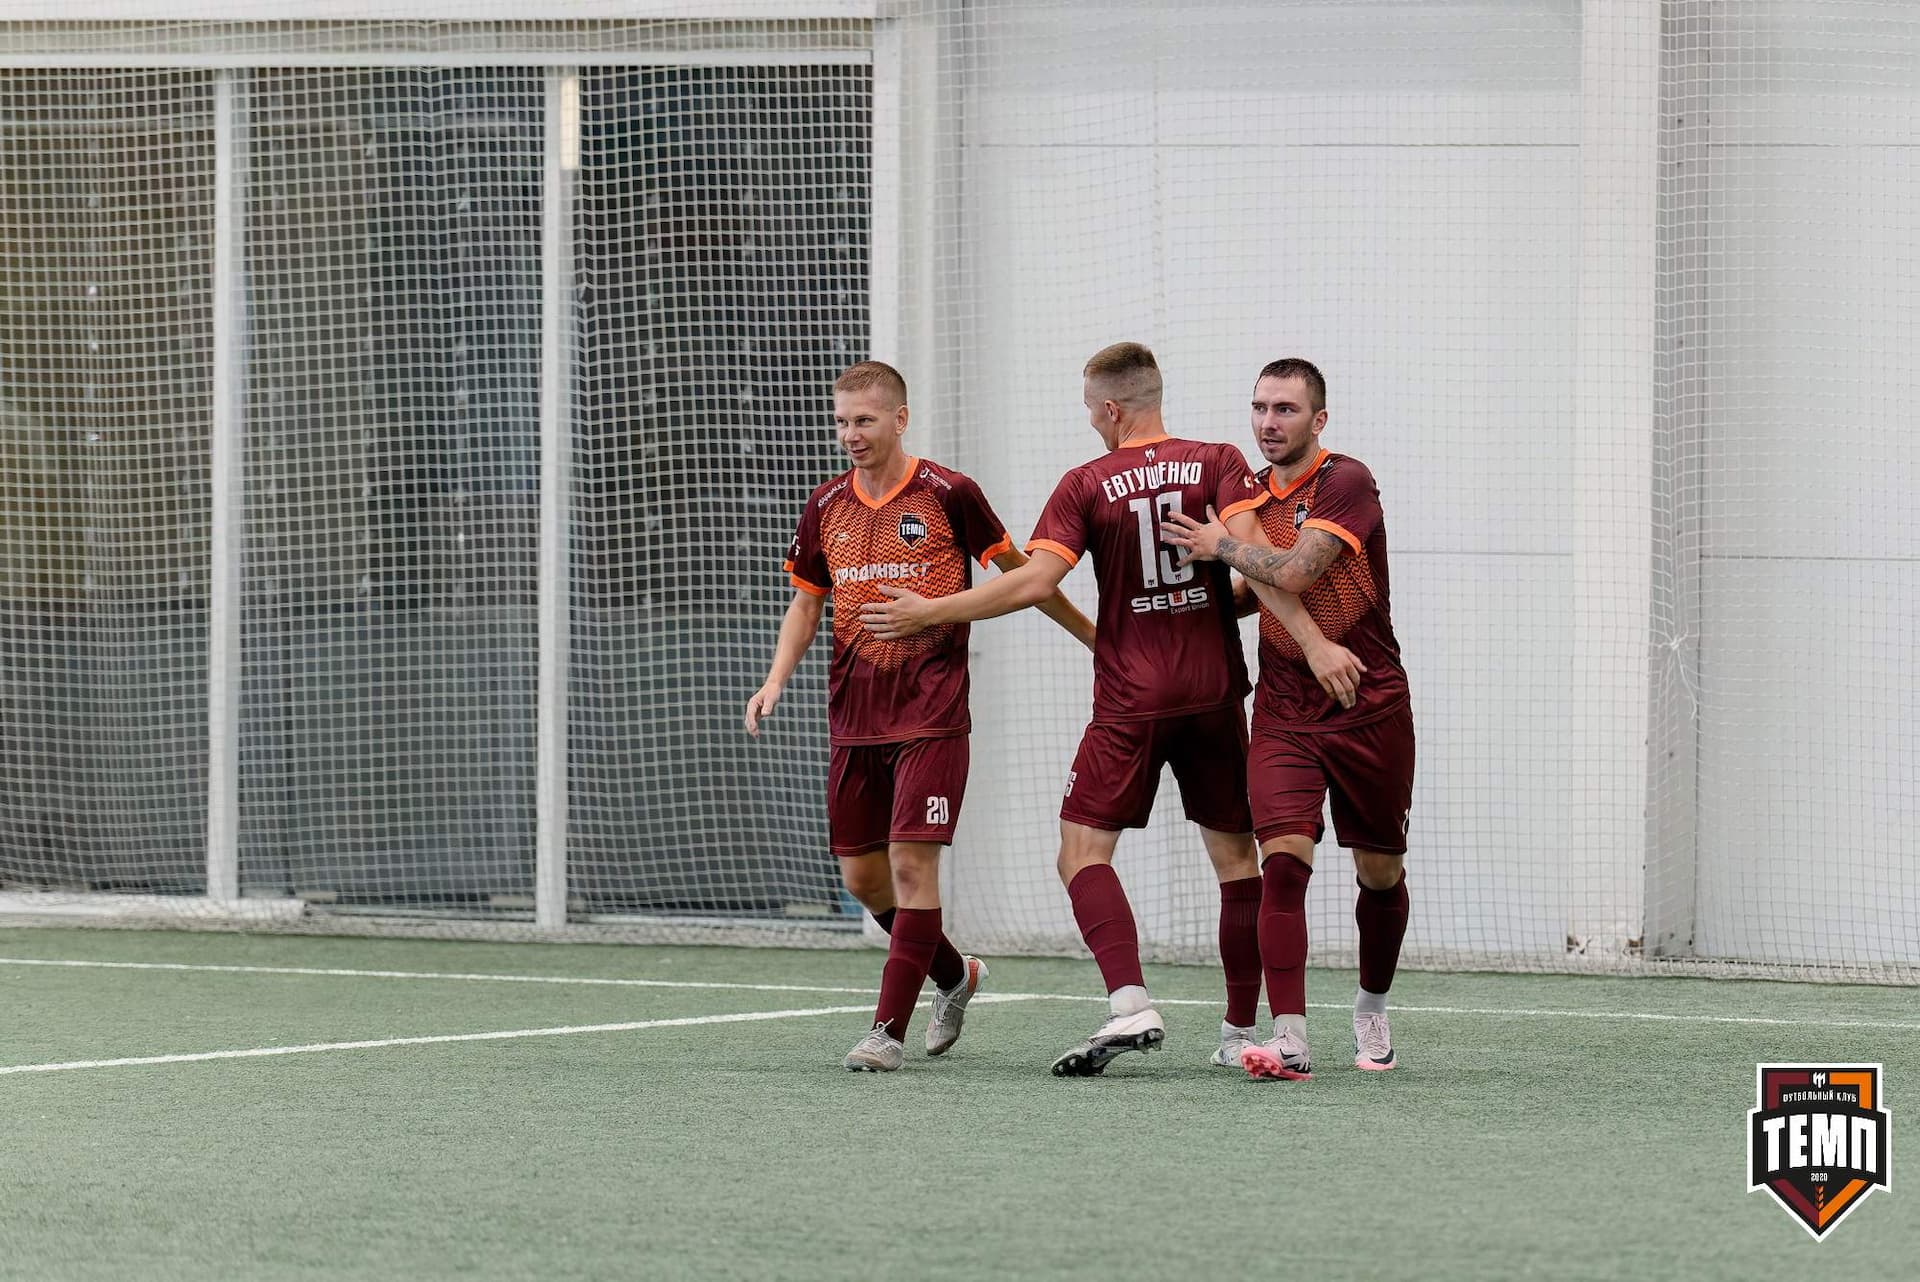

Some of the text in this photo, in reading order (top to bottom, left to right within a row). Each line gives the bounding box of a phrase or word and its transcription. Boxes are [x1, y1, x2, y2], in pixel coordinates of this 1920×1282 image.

[1102, 461, 1202, 503] ЕВТУШЕНКО
[901, 523, 925, 537] ТЕМП
[1131, 586, 1208, 613] SEUS
[926, 796, 949, 825] 20
